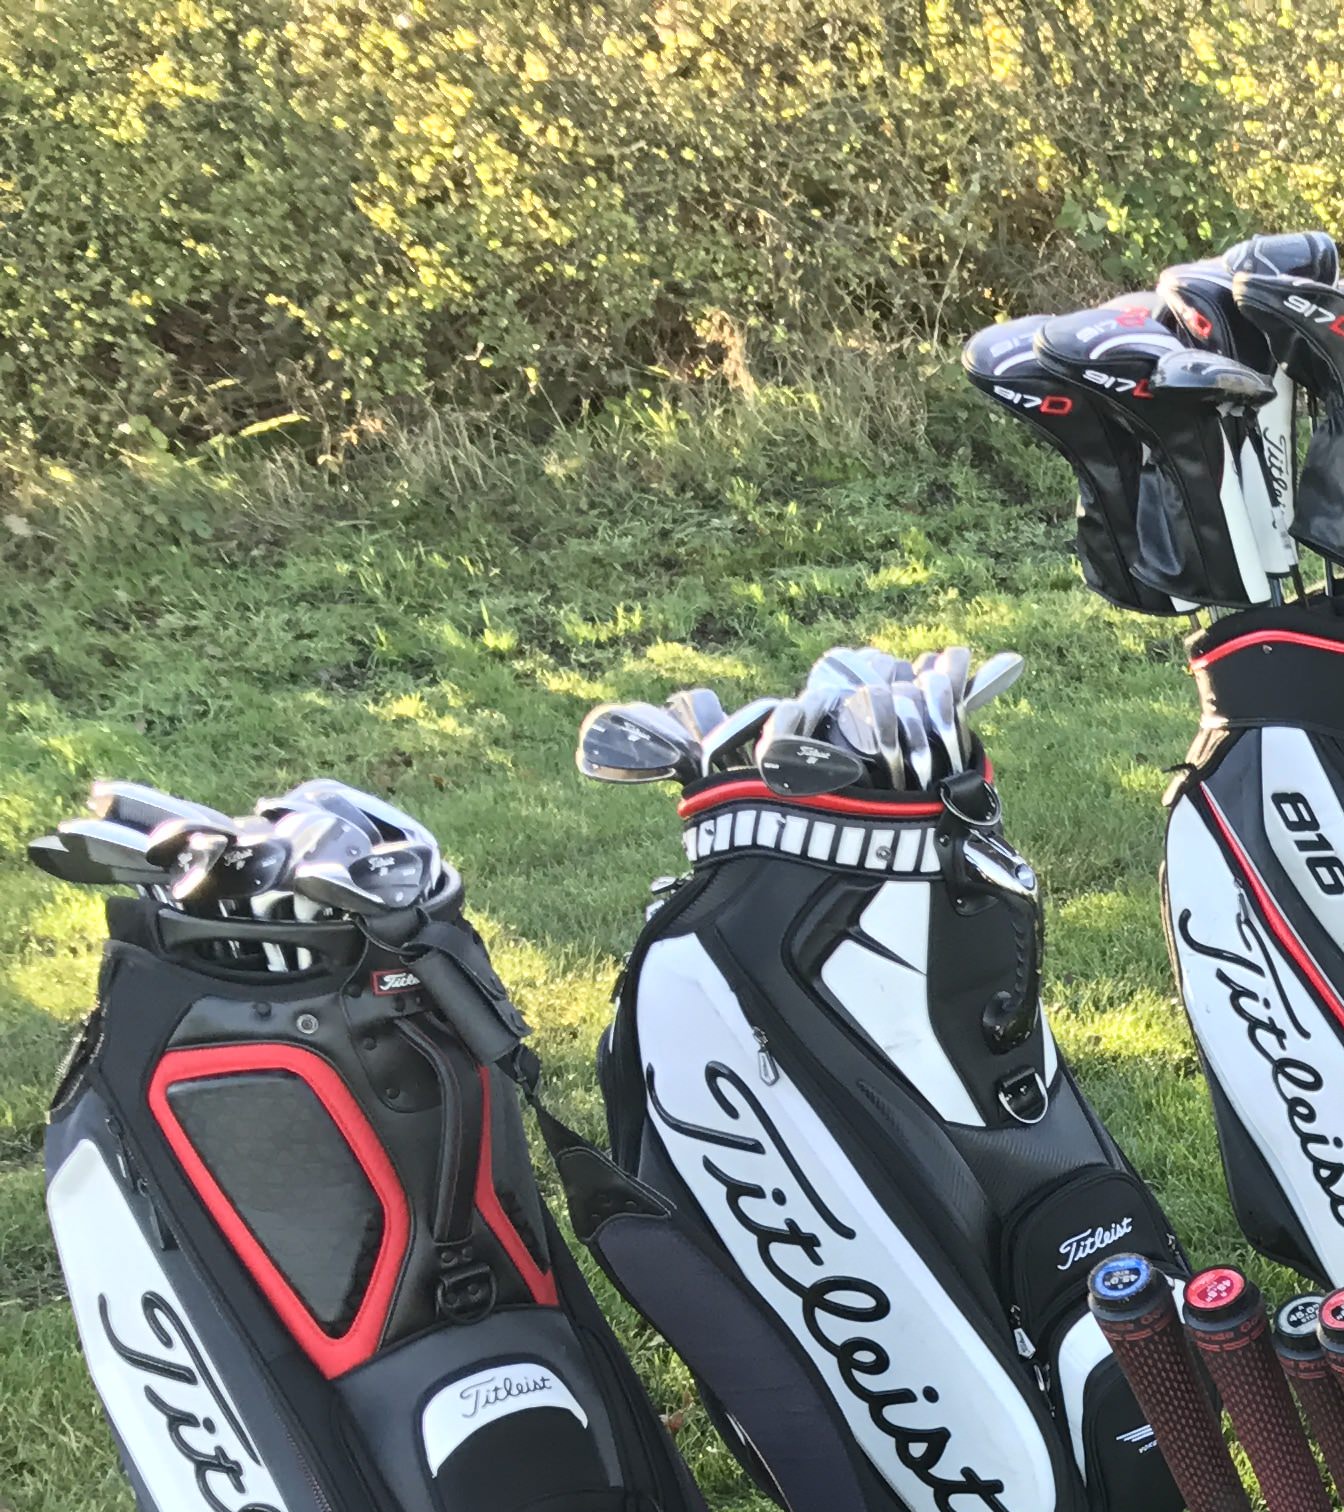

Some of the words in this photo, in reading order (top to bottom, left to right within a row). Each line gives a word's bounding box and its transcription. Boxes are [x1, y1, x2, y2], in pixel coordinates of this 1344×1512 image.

[994, 385, 1072, 416] 917D
[1057, 1217, 1133, 1270] Titleist
[459, 1374, 552, 1418] Titleist
